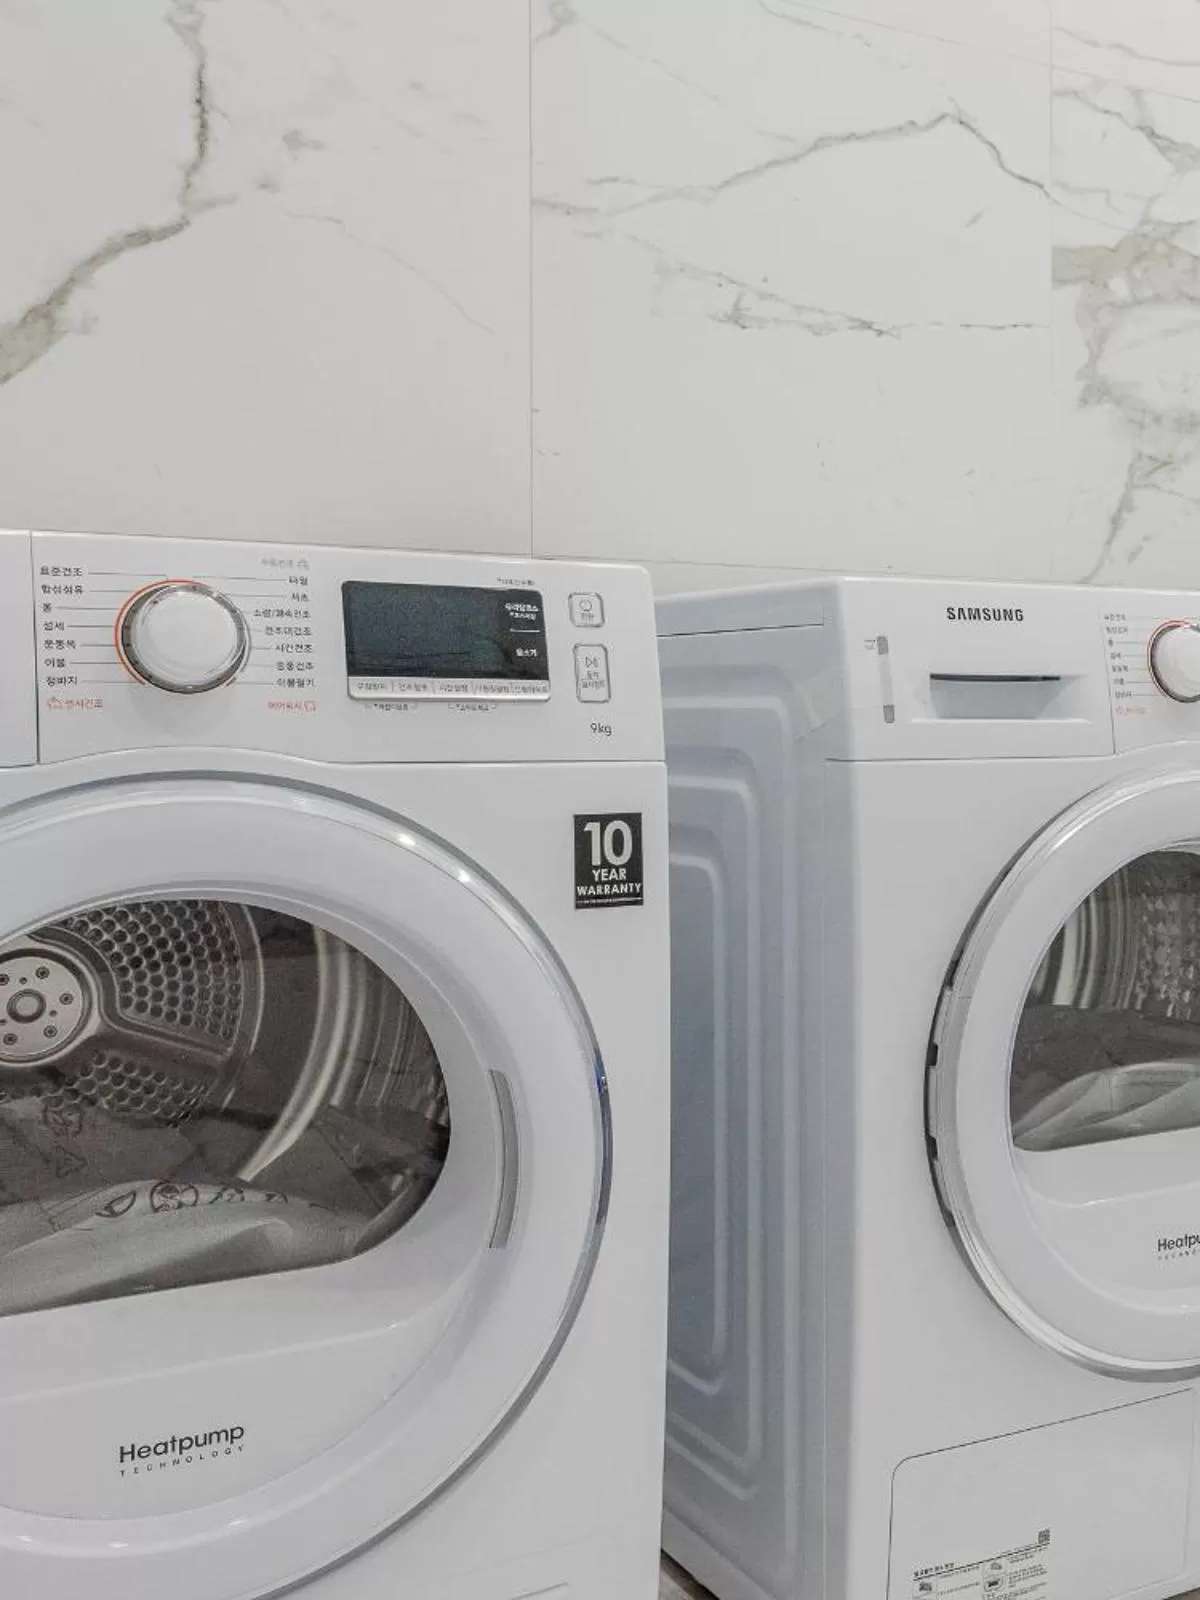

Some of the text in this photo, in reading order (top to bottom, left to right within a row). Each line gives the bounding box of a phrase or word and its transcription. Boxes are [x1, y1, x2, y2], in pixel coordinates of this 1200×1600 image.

[946, 606, 1024, 622] SAMSUNG
[590, 723, 612, 736] 9kg
[583, 820, 633, 866] 10
[592, 868, 627, 881] YEAR
[577, 883, 641, 896] WARRANTY
[119, 1426, 245, 1463] Heatpump
[119, 1444, 244, 1478] TECHNOLOGY
